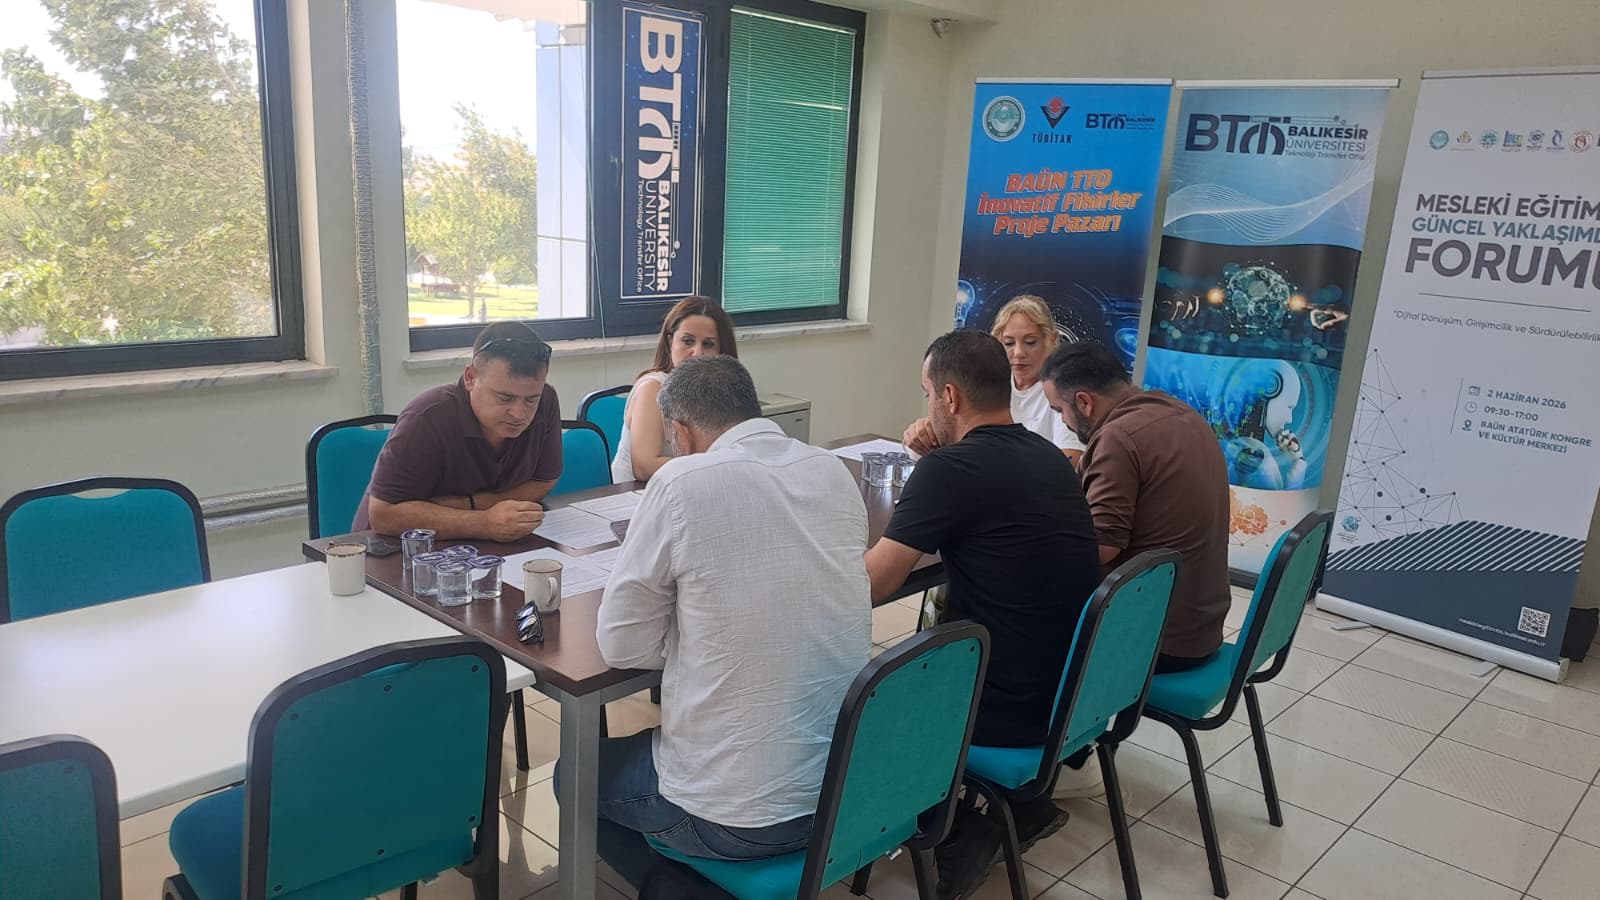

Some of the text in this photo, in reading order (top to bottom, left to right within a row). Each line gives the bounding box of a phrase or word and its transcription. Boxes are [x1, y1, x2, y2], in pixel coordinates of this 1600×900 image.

[1032, 132, 1072, 144] TÜBİTAK
[1288, 124, 1368, 140] BALIKESİR
[1286, 138, 1366, 152] ÜNİVERSİTESİ
[1005, 168, 1113, 193] BAÜN TTO
[636, 180, 645, 229] Technology
[1416, 192, 1600, 221] MESLEKİ EĞİTİM
[644, 181, 657, 291] UNIVERSITY
[993, 215, 1049, 238] Proje
[1412, 215, 1486, 236] GÜNCEL
[636, 232, 644, 266] Transfer
[1405, 237, 1600, 290] FORUM
[1515, 325, 1527, 333] ve
[1488, 390, 1567, 410] 2 HAZİRAN 2026
[1478, 431, 1567, 453] VE KÜLTÜR MERKEZİ
[1481, 420, 1592, 447] BAÜN ATATÜRK KONGRE
